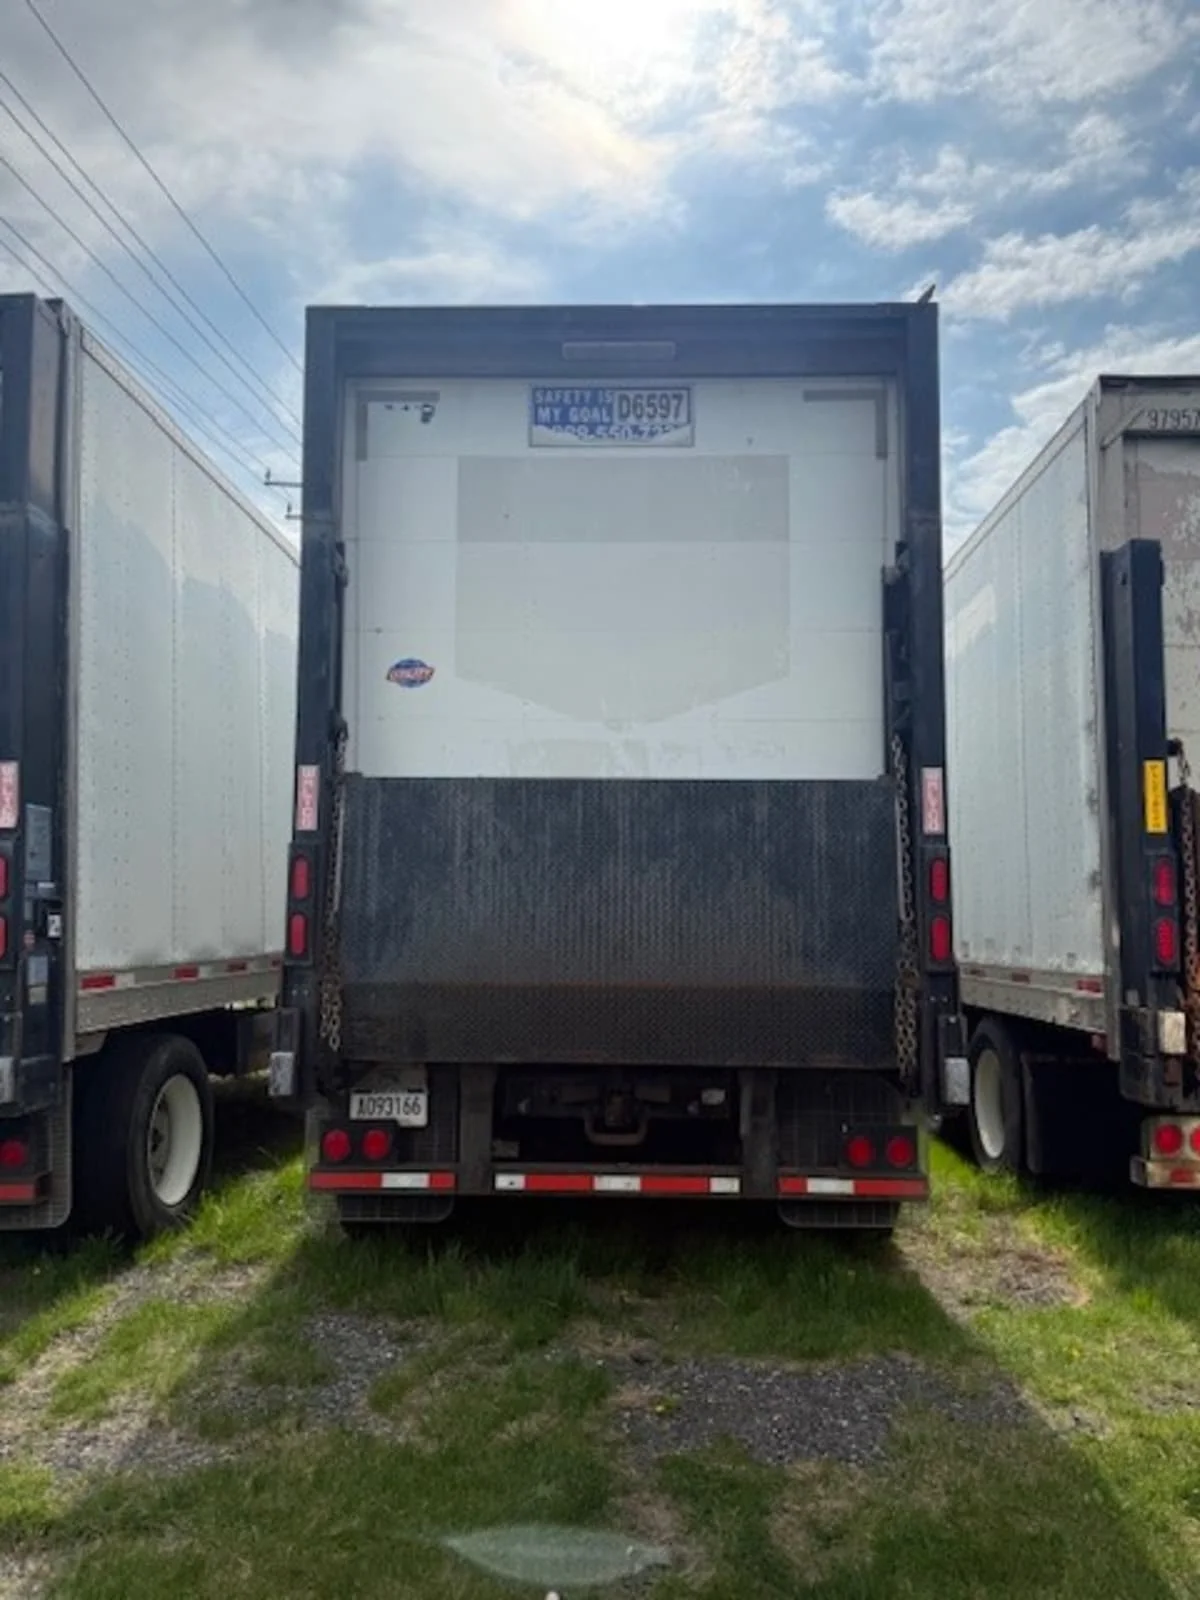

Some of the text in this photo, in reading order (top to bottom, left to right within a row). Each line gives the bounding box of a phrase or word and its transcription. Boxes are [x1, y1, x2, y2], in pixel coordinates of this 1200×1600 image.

[534, 389, 614, 404] SAFETY IS
[536, 406, 611, 423] MY GOAL
[618, 393, 684, 420] D6597
